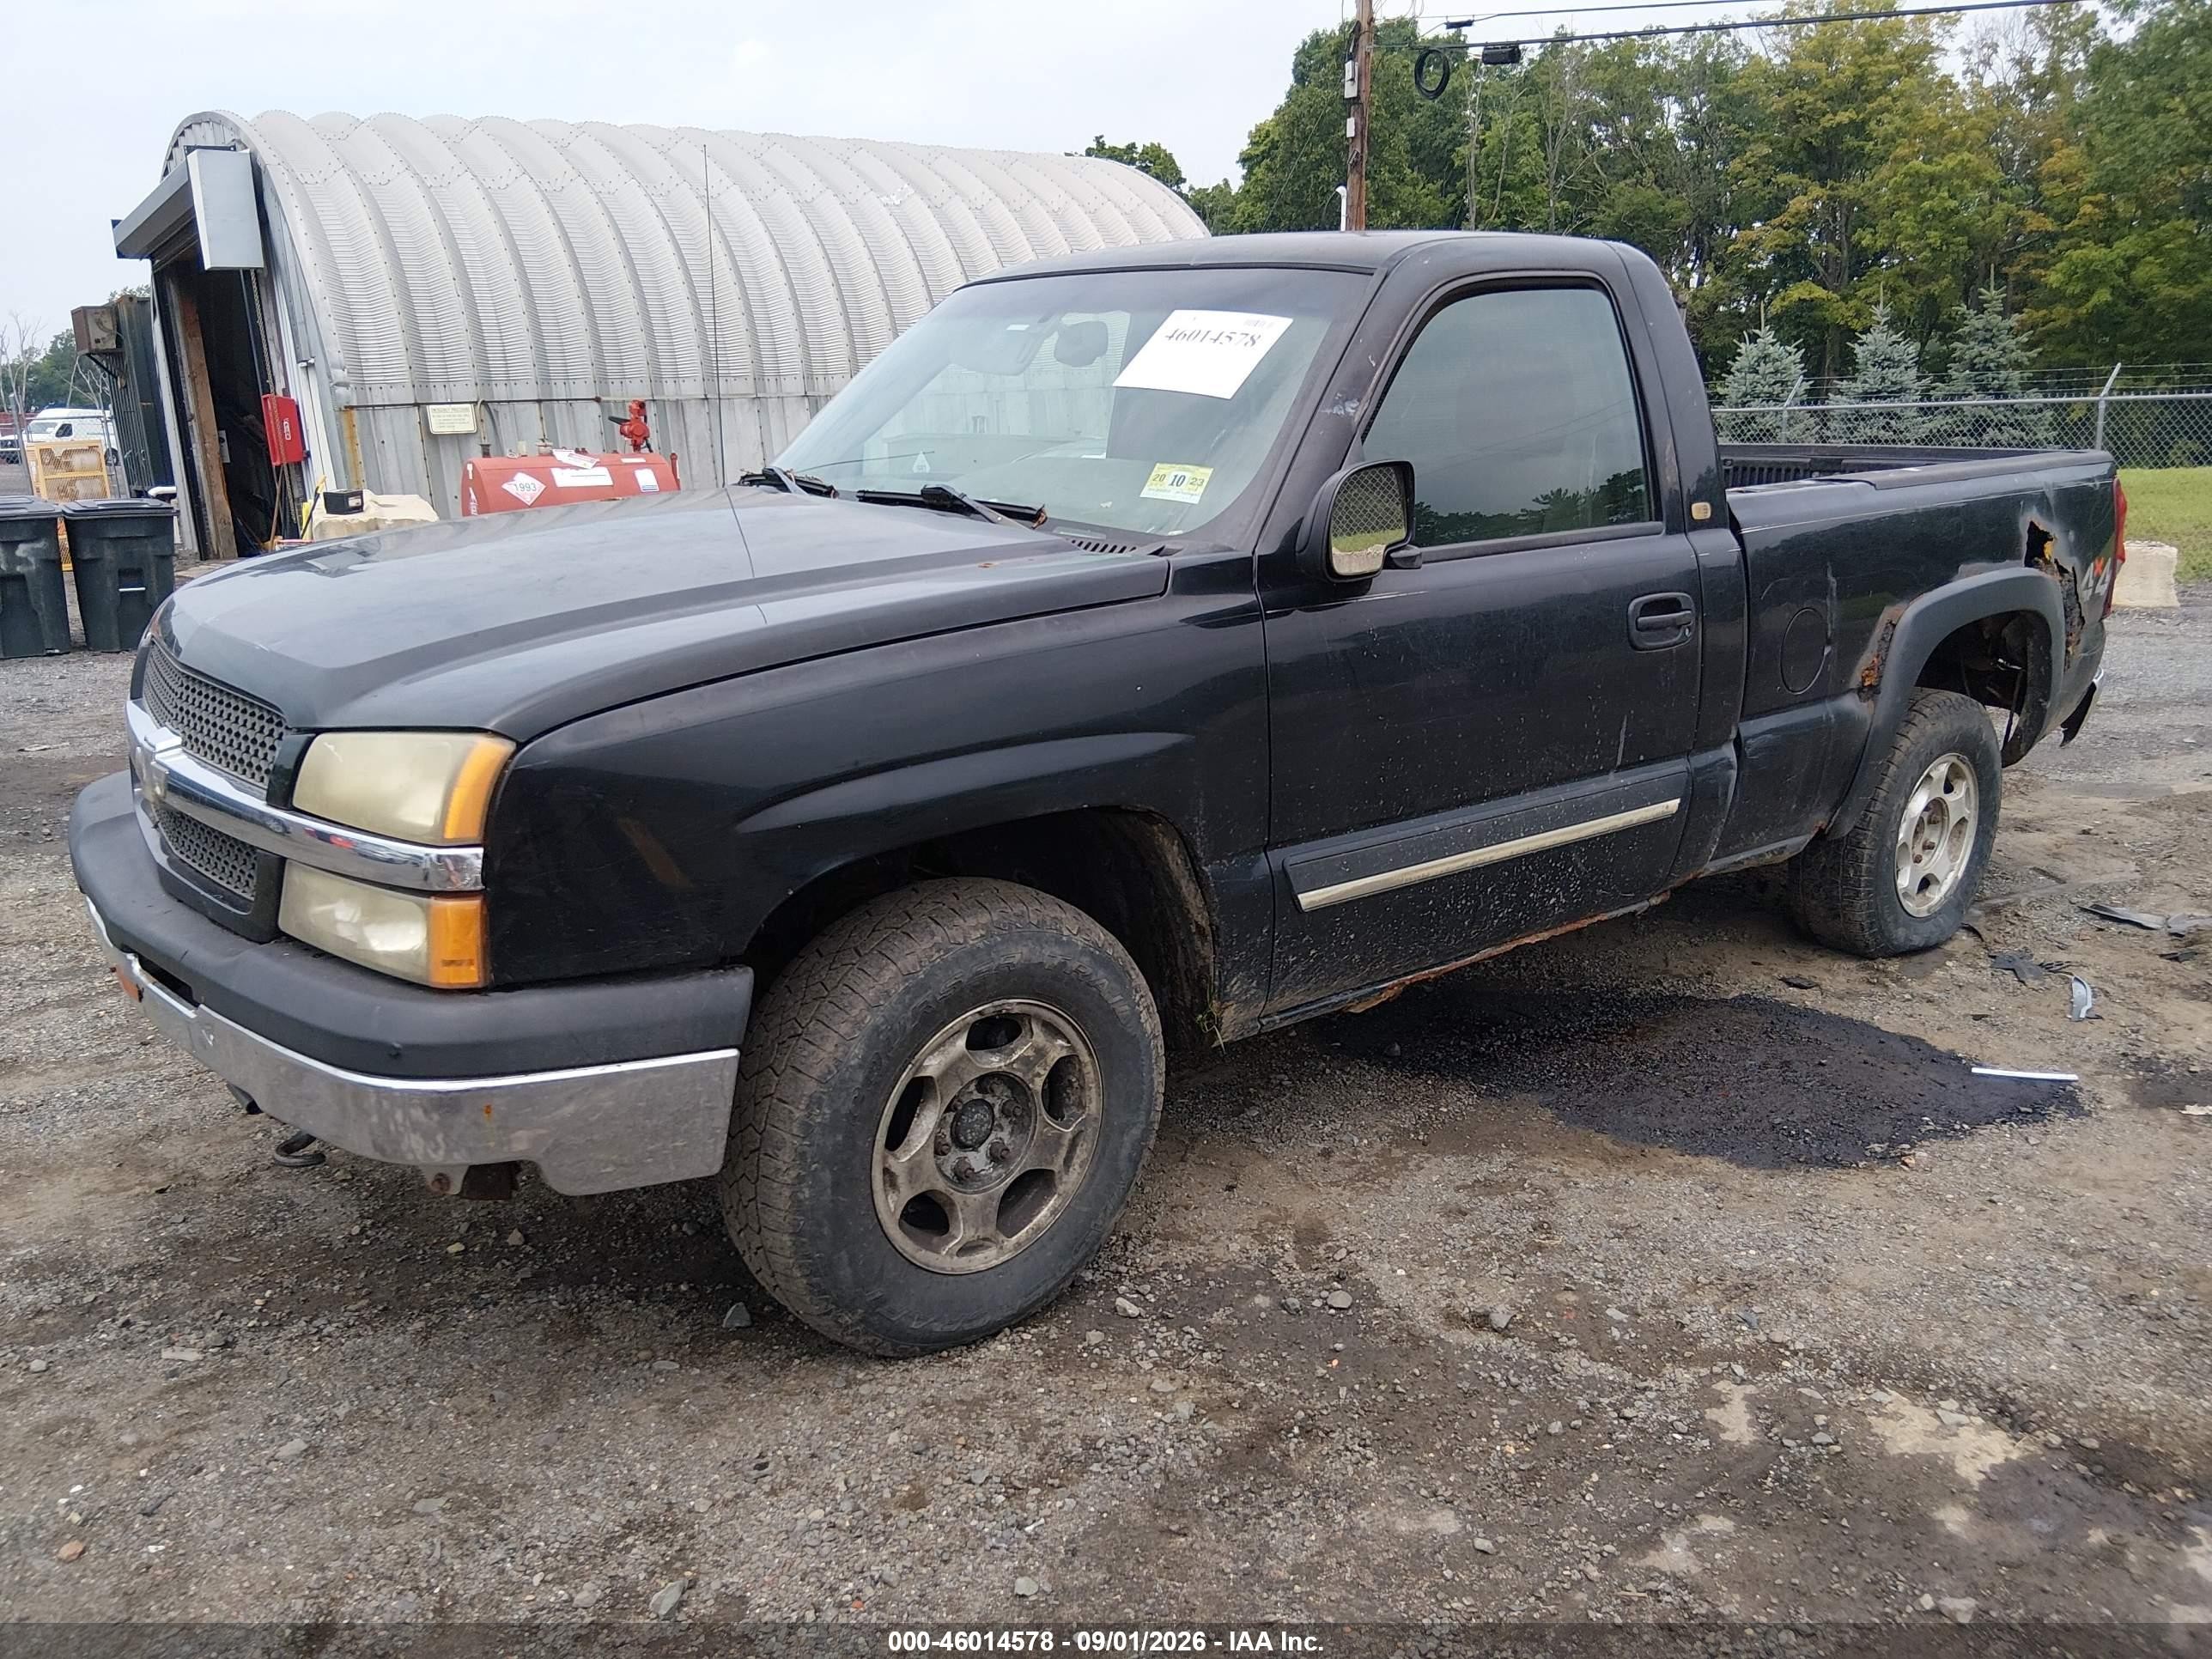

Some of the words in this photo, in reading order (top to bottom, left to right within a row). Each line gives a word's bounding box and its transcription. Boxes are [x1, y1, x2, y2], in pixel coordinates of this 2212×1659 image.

[1165, 328, 1264, 347] 46014578
[1152, 473, 1166, 482] 20
[1169, 473, 1186, 487] 10
[1189, 477, 1204, 487] 23
[513, 483, 537, 492] 1993
